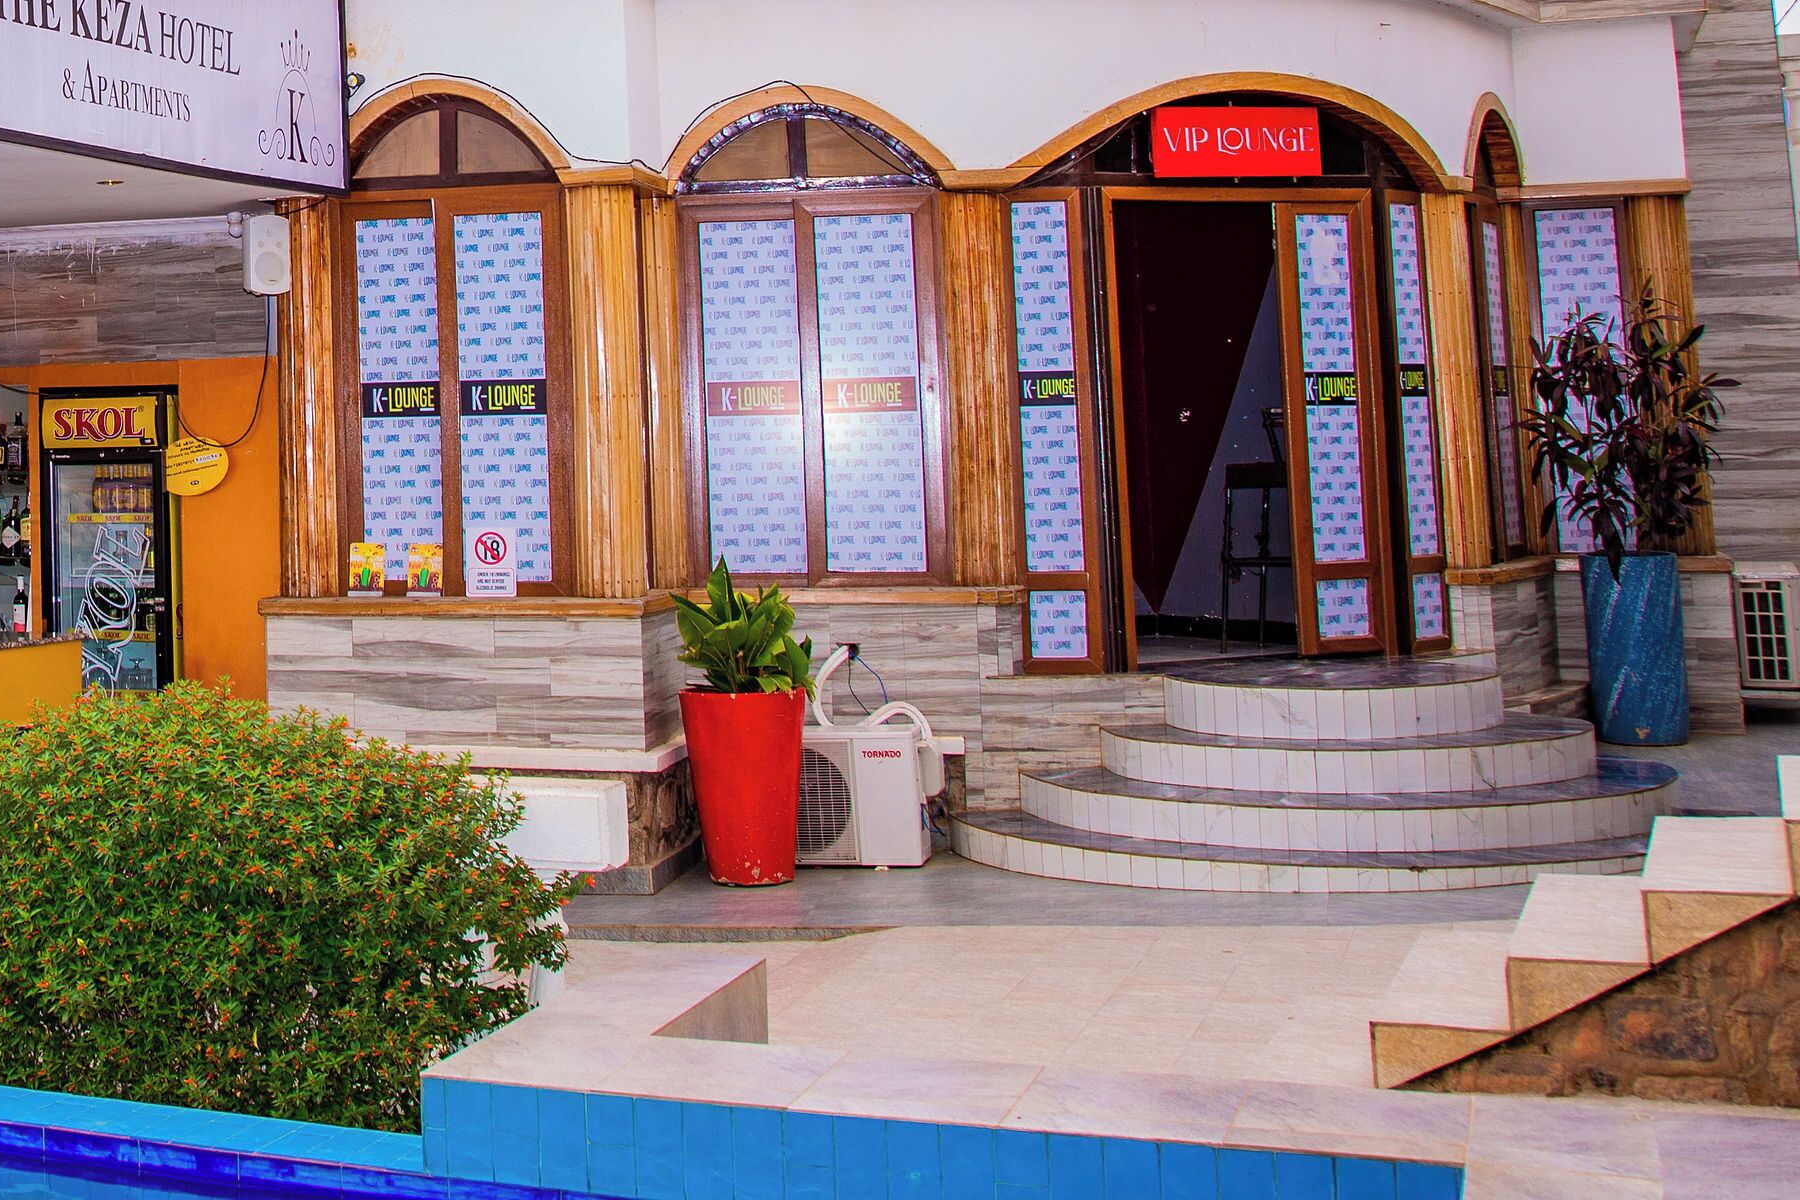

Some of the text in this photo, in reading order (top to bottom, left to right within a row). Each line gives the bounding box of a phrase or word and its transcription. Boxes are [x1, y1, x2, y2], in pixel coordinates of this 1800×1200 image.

[158, 12, 241, 75] HOTEL
[62, 59, 191, 123] & APARTMENTS
[287, 88, 308, 164] K
[1163, 127, 1315, 155] VIP LOUNGE
[372, 385, 435, 413] K-LOUNGE
[471, 385, 535, 411] K-LOUNGE
[721, 386, 785, 412] K-LOUNGE
[837, 382, 903, 408] K-LOUNGE
[1023, 379, 1075, 399] K-LOUNGE
[1305, 377, 1356, 400] K-LOUNGE
[53, 406, 145, 441] SKOL
[484, 540, 500, 560] 18
[862, 750, 902, 759] TORNADO
